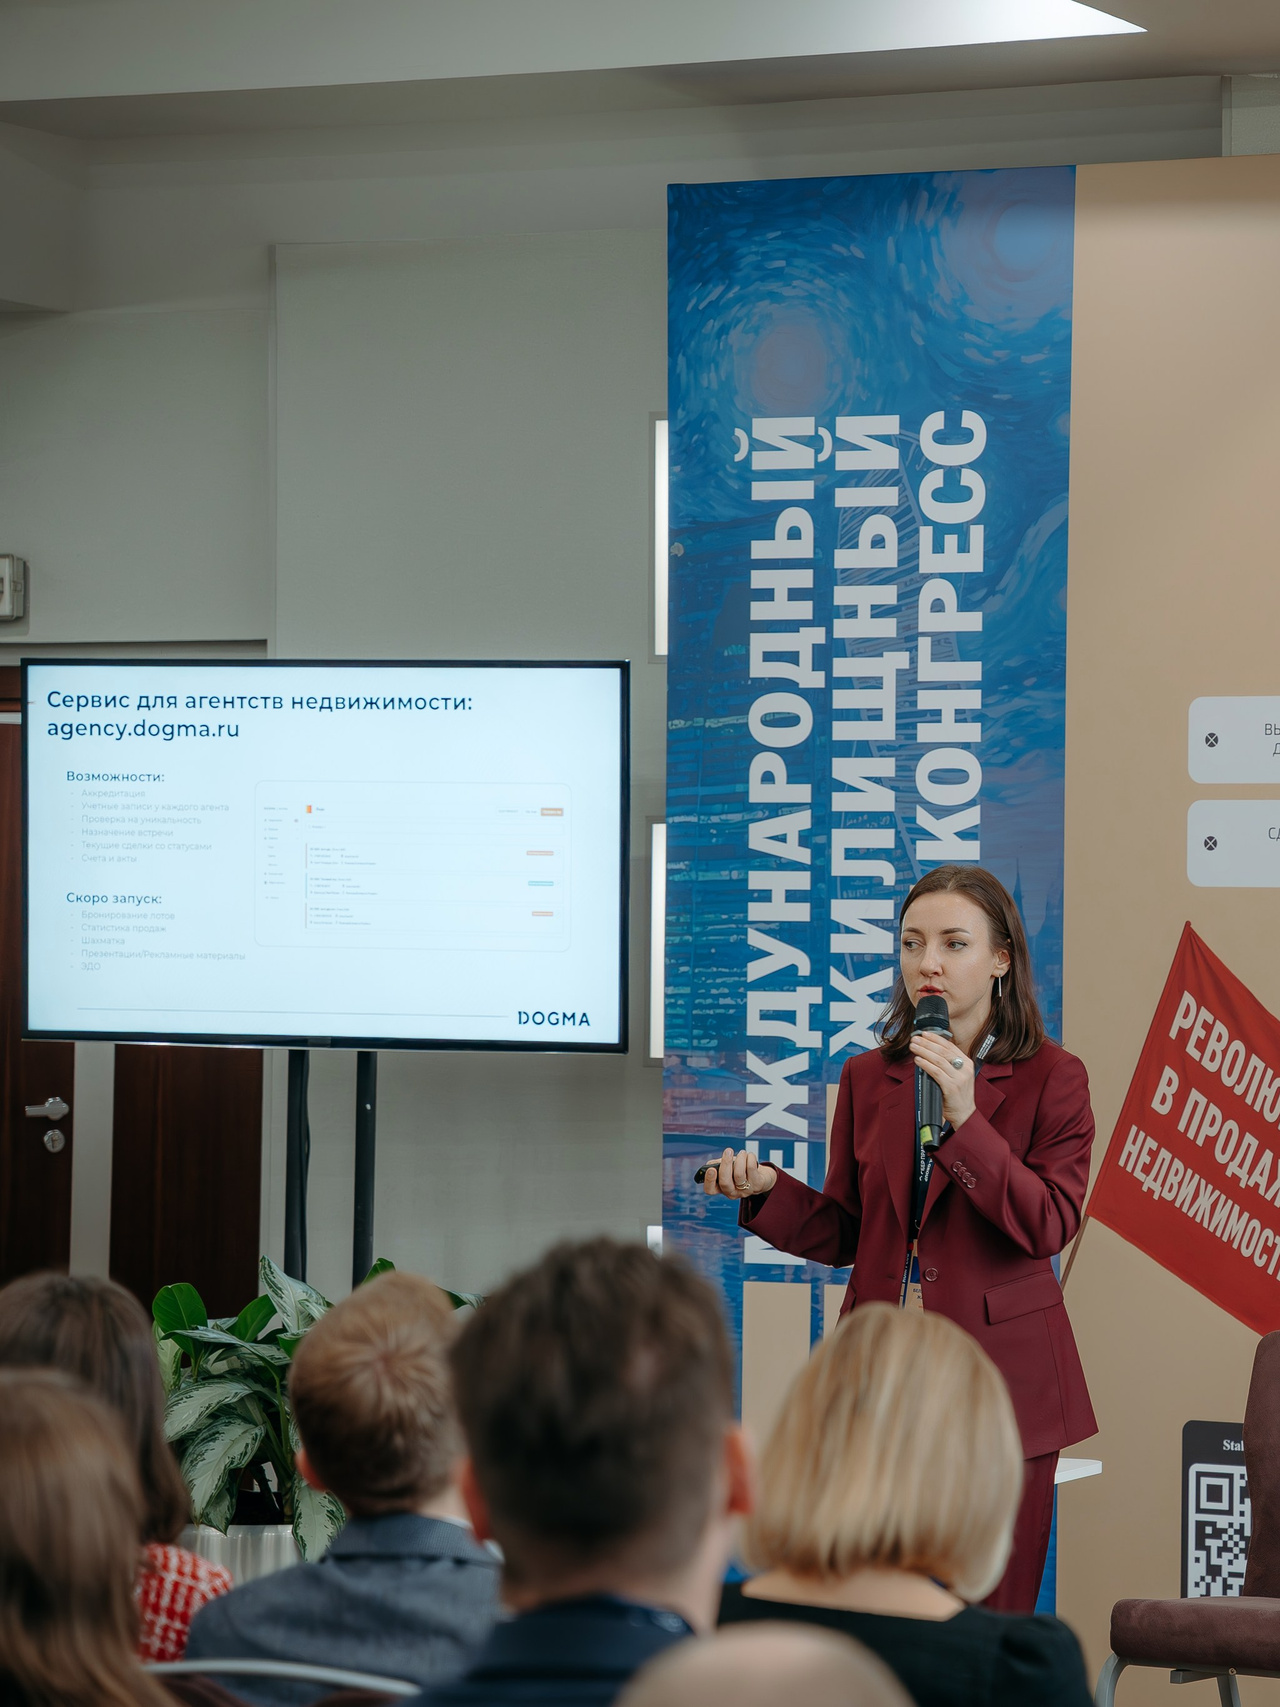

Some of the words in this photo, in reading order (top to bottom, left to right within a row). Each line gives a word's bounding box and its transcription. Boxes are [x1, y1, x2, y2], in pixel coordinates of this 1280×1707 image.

[915, 408, 988, 861] КОНГРЕСС
[48, 691, 129, 712] Сервис
[137, 696, 177, 710] для
[186, 696, 283, 709] агентств
[292, 697, 471, 712] недвижимости:
[48, 719, 238, 741] agency.dogma.ru
[67, 771, 165, 781] Возможности:
[82, 789, 145, 798] Аккредитация
[121, 803, 153, 811] записи
[155, 804, 160, 812] у
[162, 803, 199, 812] каждого
[82, 815, 126, 825] Проверка
[141, 816, 201, 825] уникальность
[138, 830, 173, 838] встречи
[734, 415, 826, 1266] ЕЖДУНАРОДНЫЙ
[82, 842, 120, 851] Текущие
[122, 842, 153, 851] сделки
[155, 842, 166, 850] со
[167, 842, 212, 851] статусами
[67, 892, 108, 905] Скоро
[113, 895, 162, 906] запуск:
[81, 911, 148, 920] Бронирование
[81, 924, 130, 932] Статистика
[132, 925, 166, 933] продаж
[81, 950, 194, 959] Презентации/Рекламные
[197, 952, 246, 960] материалы
[81, 963, 101, 971] ЭДО
[518, 1011, 590, 1026] DOGMA
[1150, 1065, 1180, 1116] В
